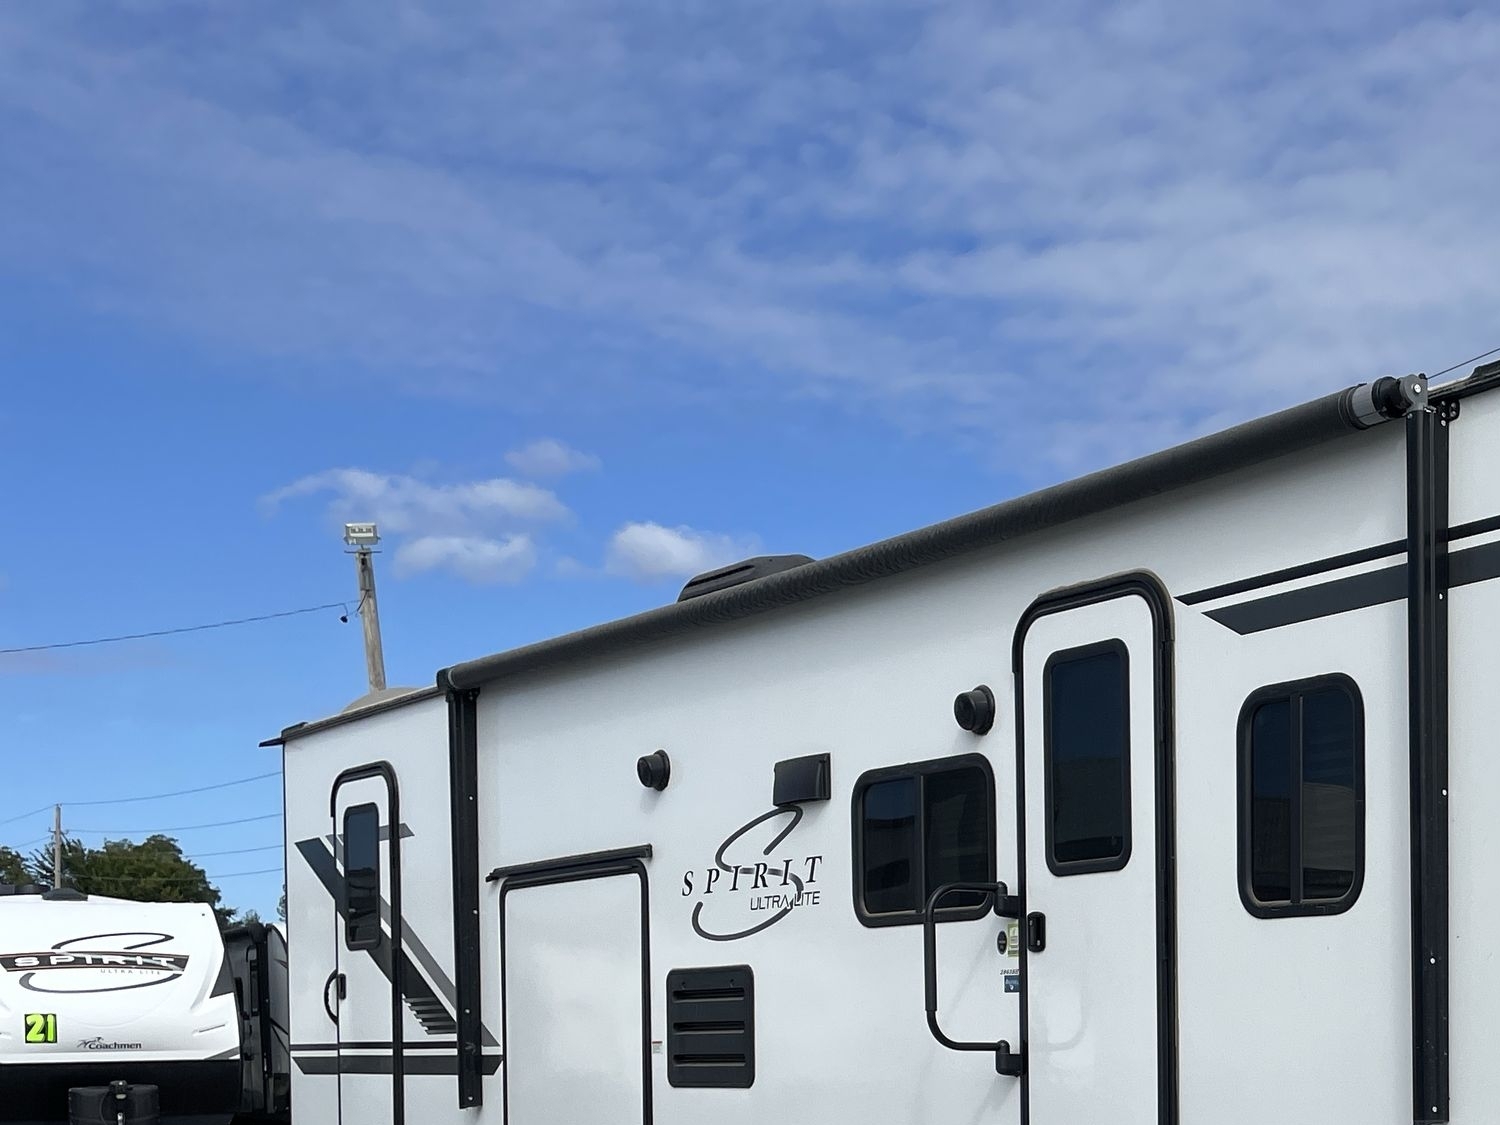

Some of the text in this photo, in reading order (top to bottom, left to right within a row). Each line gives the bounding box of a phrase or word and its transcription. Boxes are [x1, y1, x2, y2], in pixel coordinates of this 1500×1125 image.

[681, 855, 823, 897] SPIRIT
[750, 891, 821, 911] ULTRA LITE
[14, 955, 175, 968] SPIRIT
[25, 1012, 57, 1043] 21
[88, 1040, 142, 1050] Coachmen
